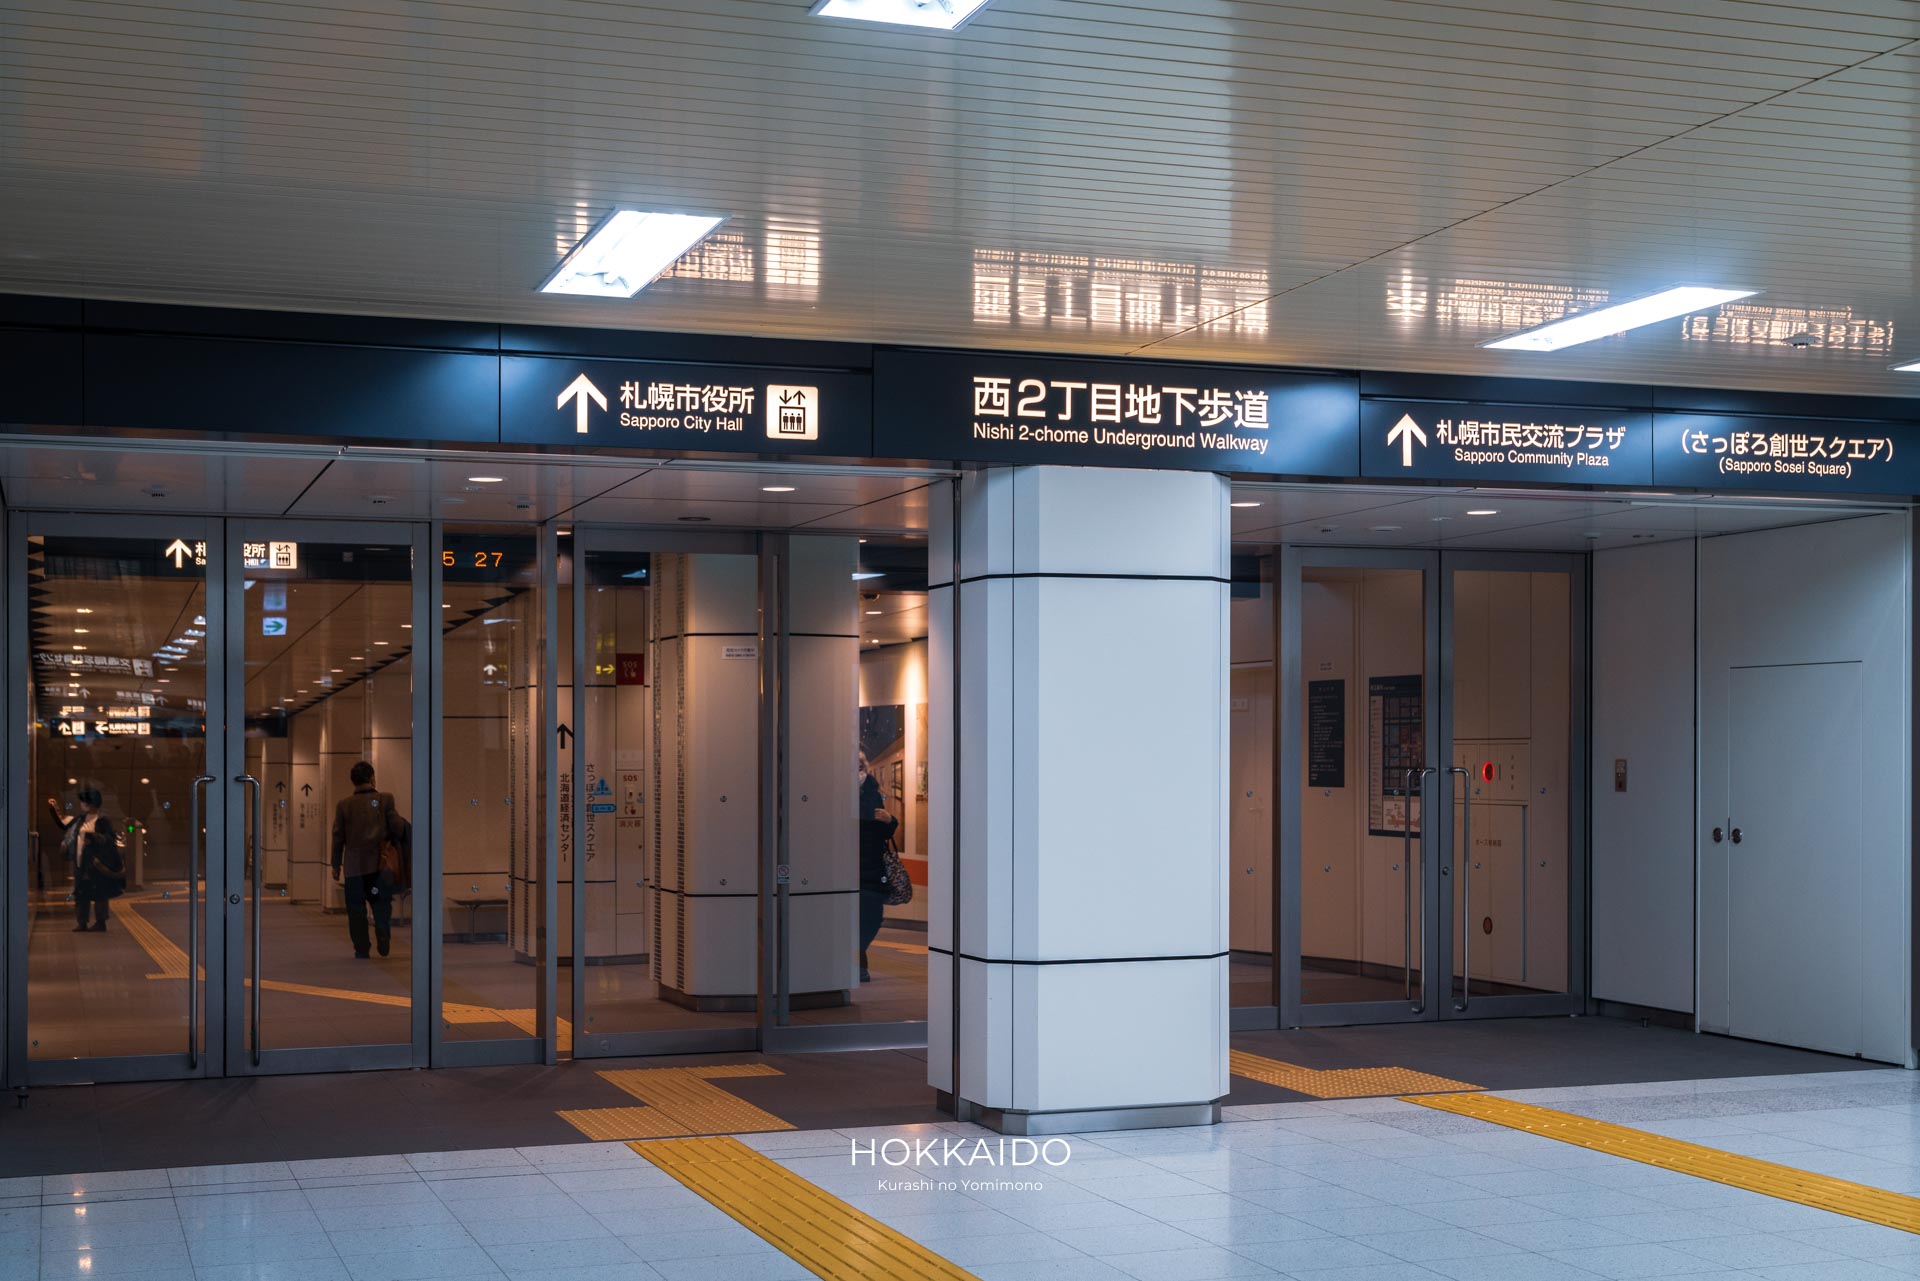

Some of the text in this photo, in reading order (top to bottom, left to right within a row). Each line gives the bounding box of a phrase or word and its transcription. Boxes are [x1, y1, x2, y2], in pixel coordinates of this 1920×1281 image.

[619, 381, 755, 414] 札幌市役所
[973, 376, 1269, 429] 西2丁目地下歩道
[620, 412, 743, 433] Sapporo City Hall
[1436, 419, 1626, 450] 札幌市民交流プラザ
[973, 422, 1269, 455] Nishi 2-chome Underground Walkway
[1681, 428, 1894, 462] (さっぽろ創世スクエア)
[1454, 448, 1609, 468] Sapporo Community Plaza
[1719, 456, 1852, 479] (Sapporo Sosei Square)
[475, 550, 504, 567] 27
[623, 774, 638, 782] SOS
